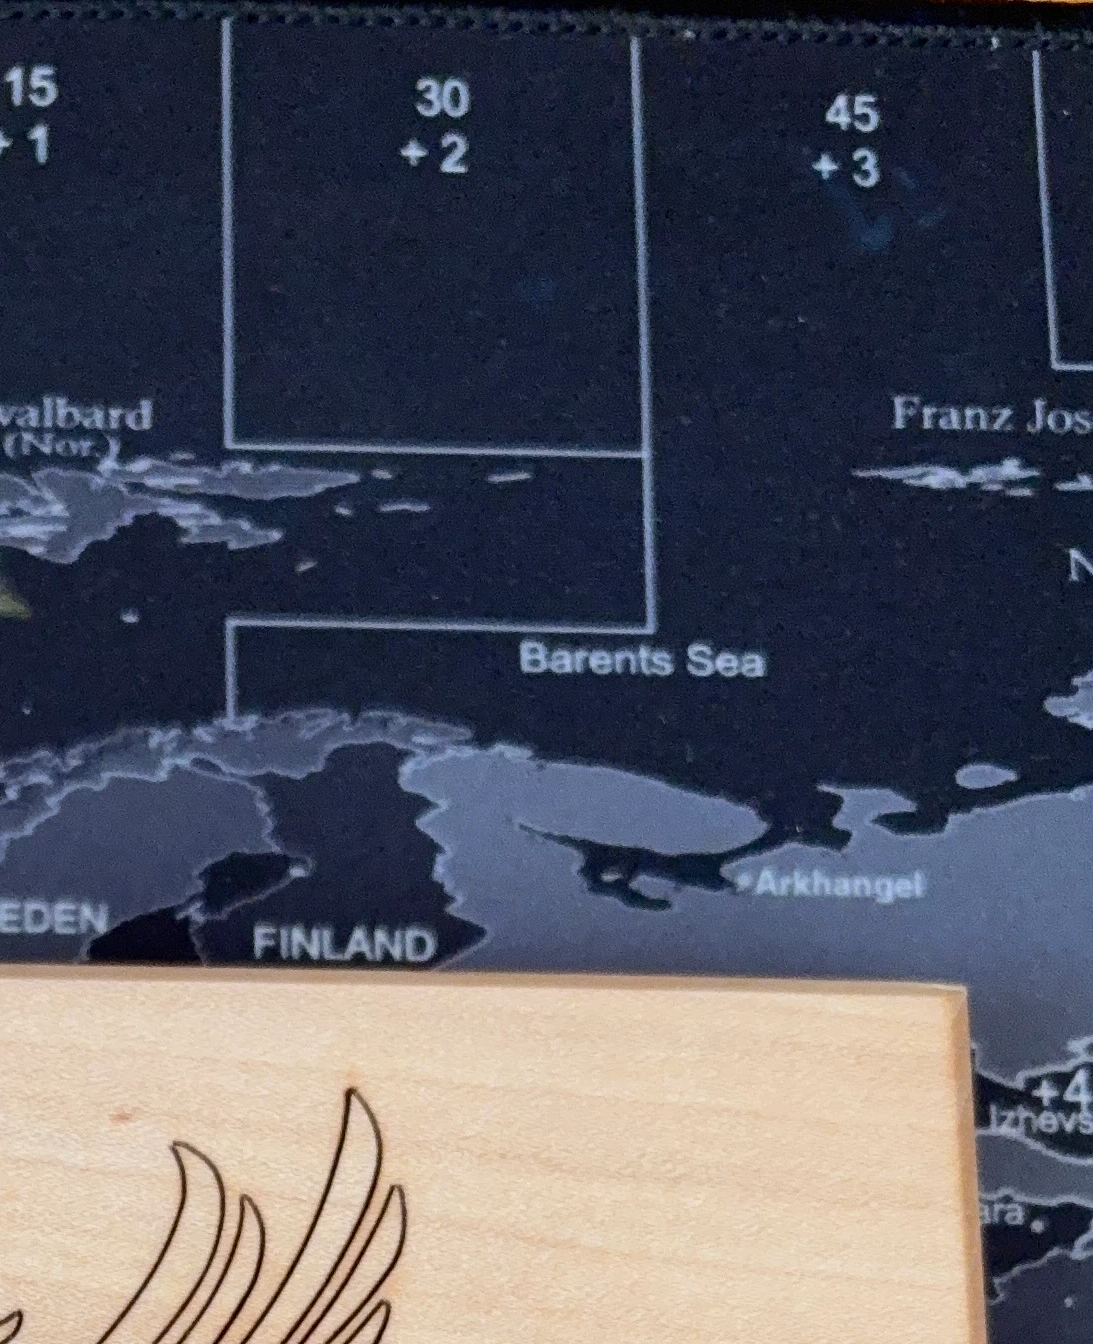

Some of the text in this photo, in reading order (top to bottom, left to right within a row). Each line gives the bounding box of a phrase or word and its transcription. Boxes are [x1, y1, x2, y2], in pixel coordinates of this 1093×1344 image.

[5, 65, 58, 107] 15
[415, 77, 470, 118] 30
[824, 94, 880, 132] 45
[891, 396, 1012, 432] Franz
[3, 432, 119, 458] (Nor.)
[519, 641, 767, 678] Barents Sea
[755, 867, 926, 902] Arkhangel
[253, 925, 437, 963] FINLAND
